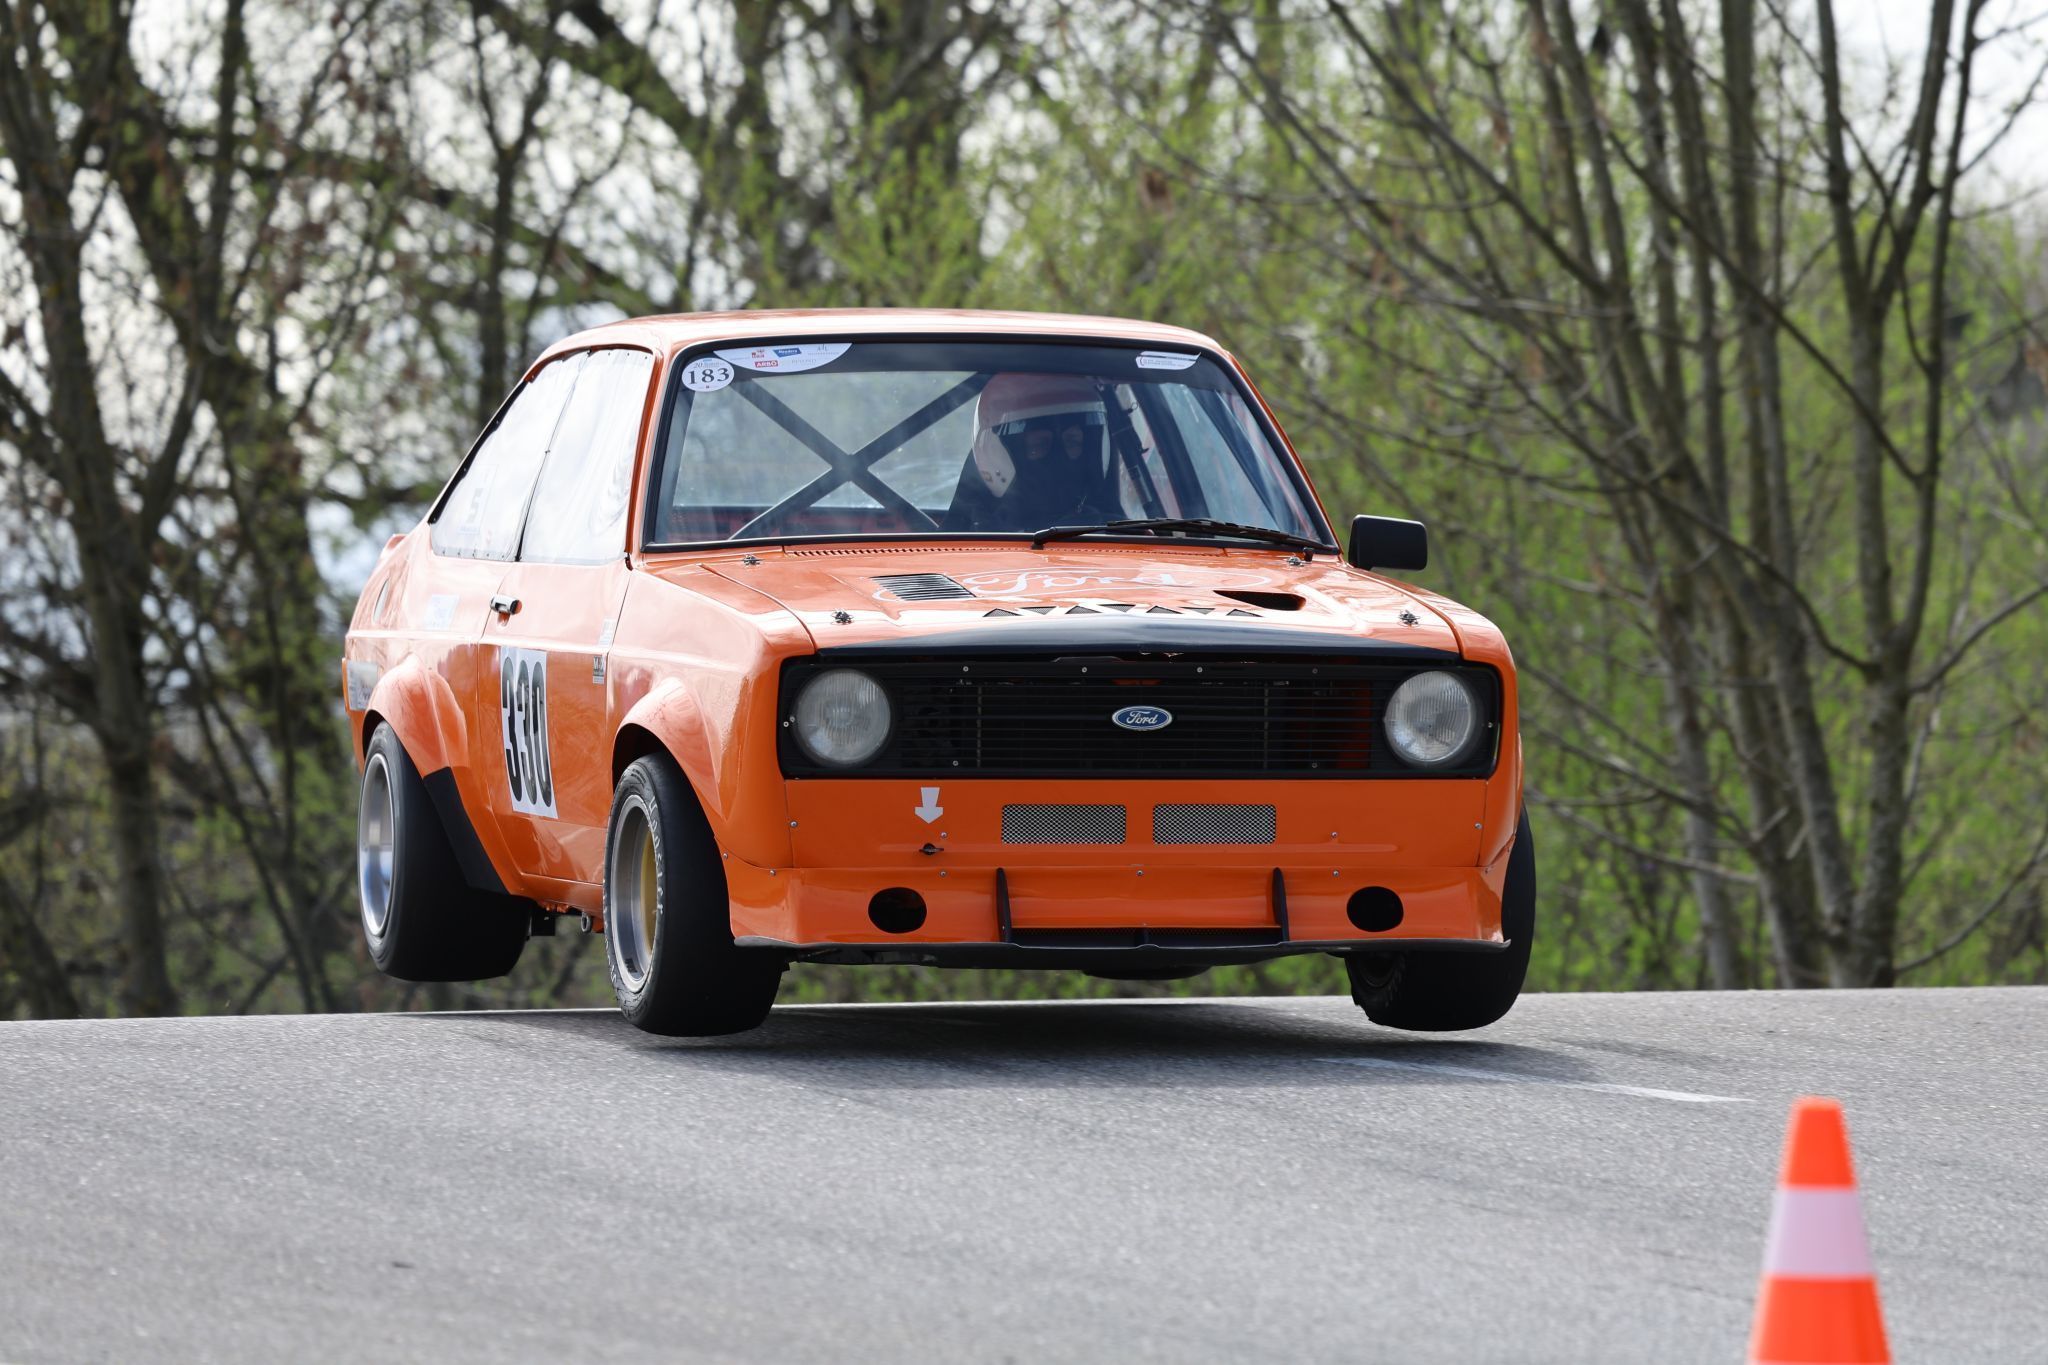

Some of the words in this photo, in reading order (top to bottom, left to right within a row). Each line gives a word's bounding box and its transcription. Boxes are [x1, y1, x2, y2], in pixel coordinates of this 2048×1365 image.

[688, 367, 730, 384] 183
[963, 569, 1192, 594] Ford
[1126, 710, 1159, 724] Ford
[501, 656, 552, 807] 330
